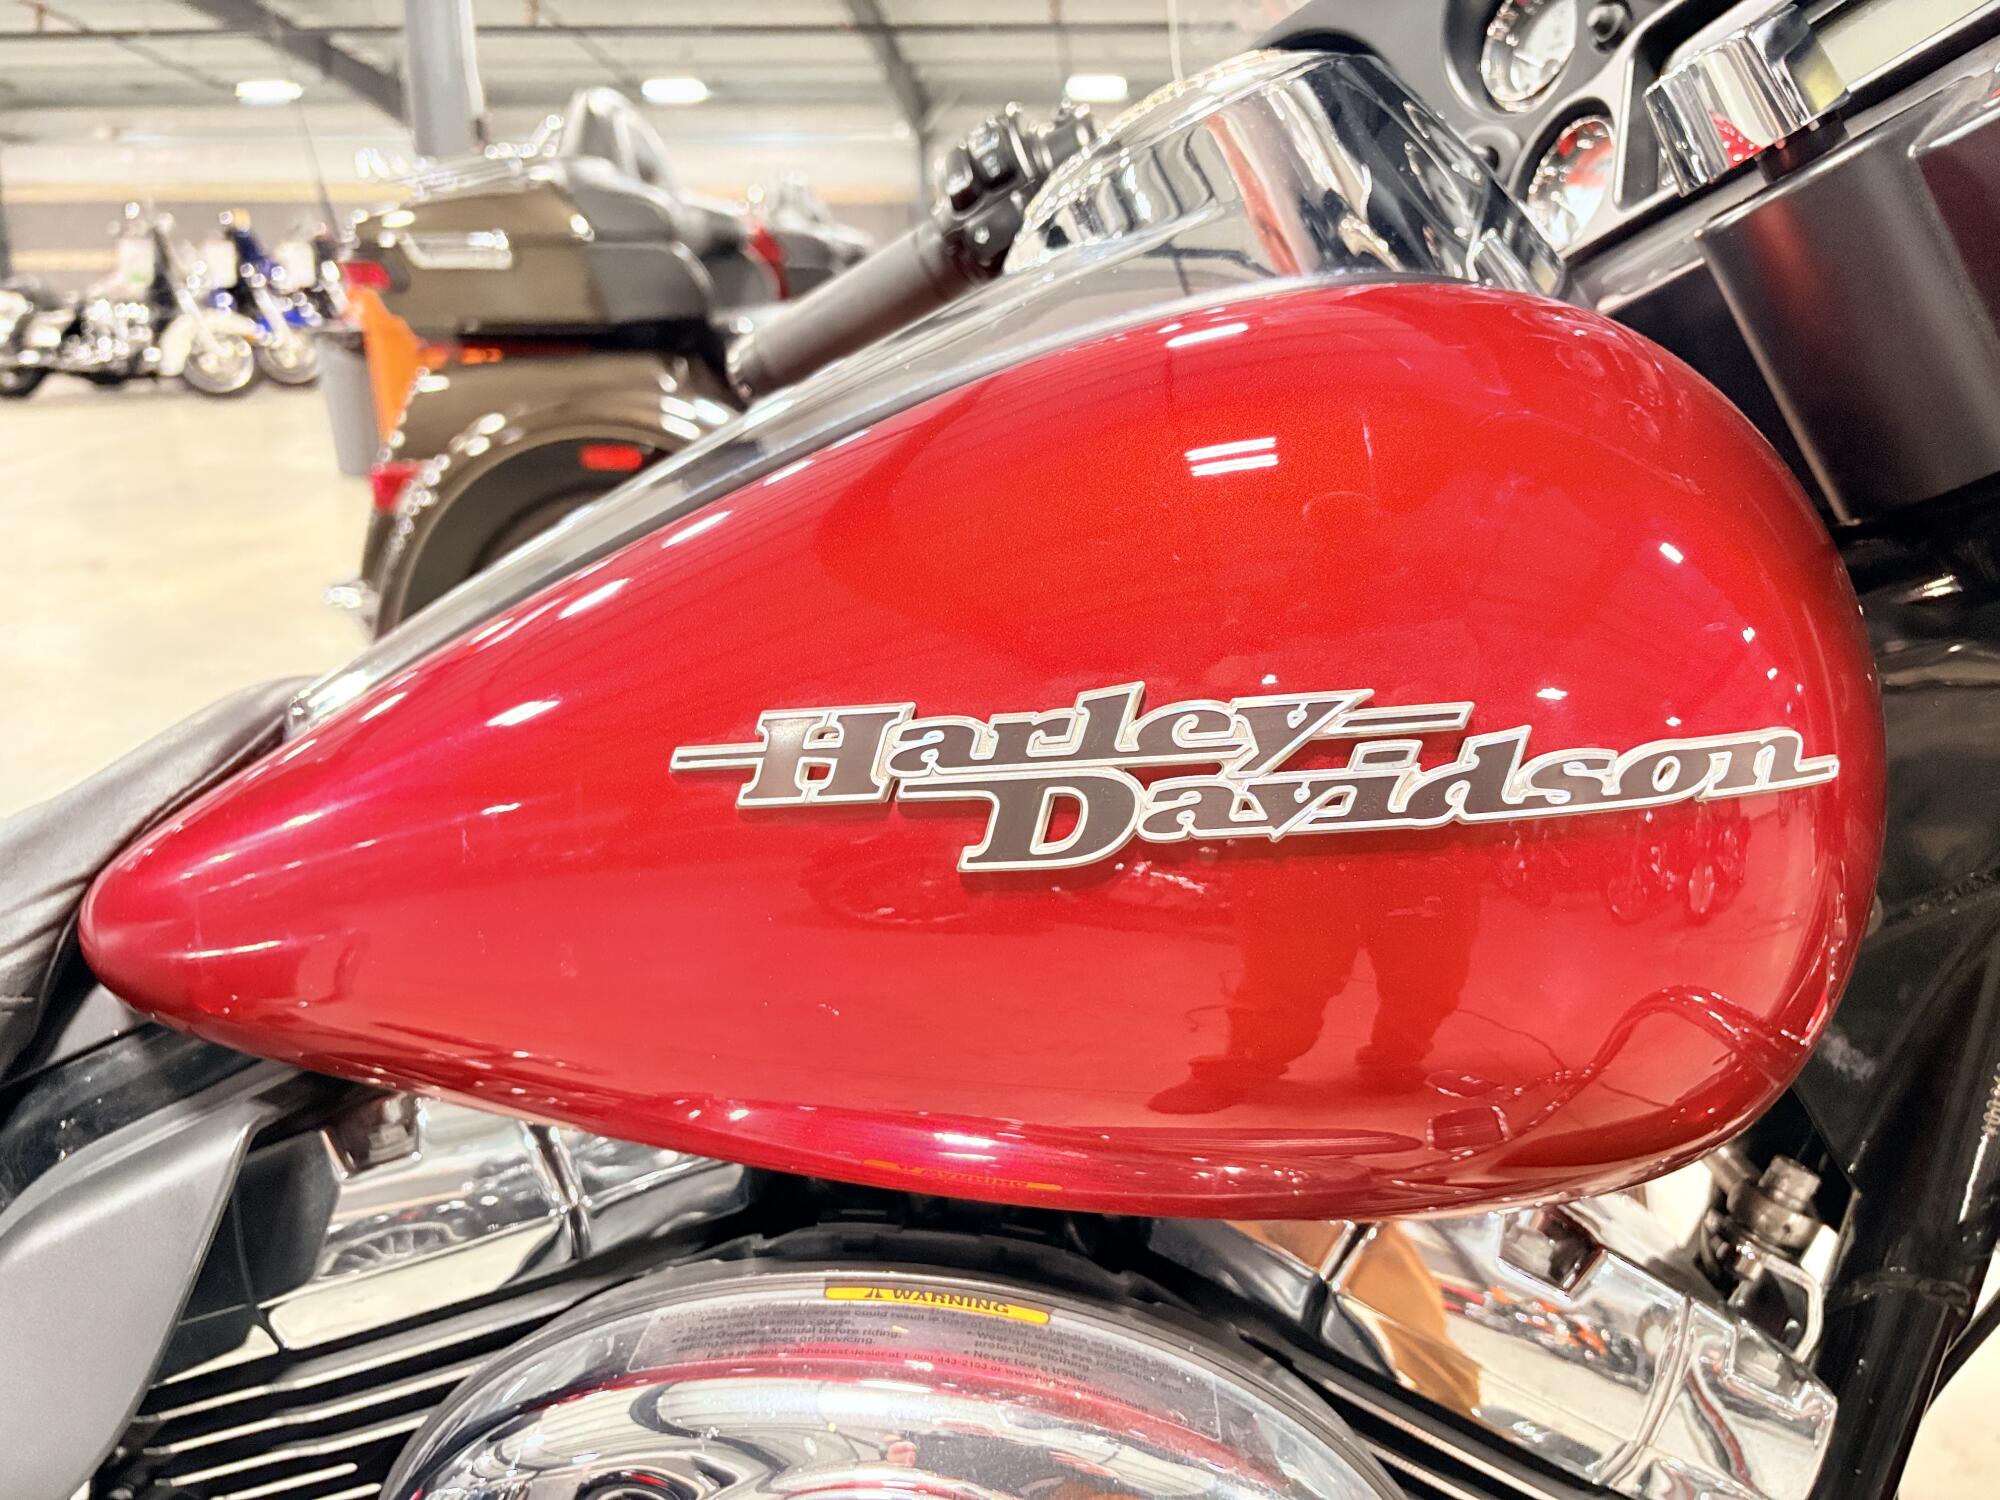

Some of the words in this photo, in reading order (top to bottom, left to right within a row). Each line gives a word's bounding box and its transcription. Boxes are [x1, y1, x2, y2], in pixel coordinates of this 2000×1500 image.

[670, 681, 1474, 810] Harley
[896, 724, 1839, 872] Davidson
[893, 1288, 1009, 1314] WARNING
[854, 1309, 888, 1318] could
[770, 1326, 816, 1335] Manual
[818, 1326, 859, 1335] before
[975, 1339, 1038, 1358] protective
[973, 1350, 1010, 1364] Never
[1014, 1358, 1038, 1370] tow
